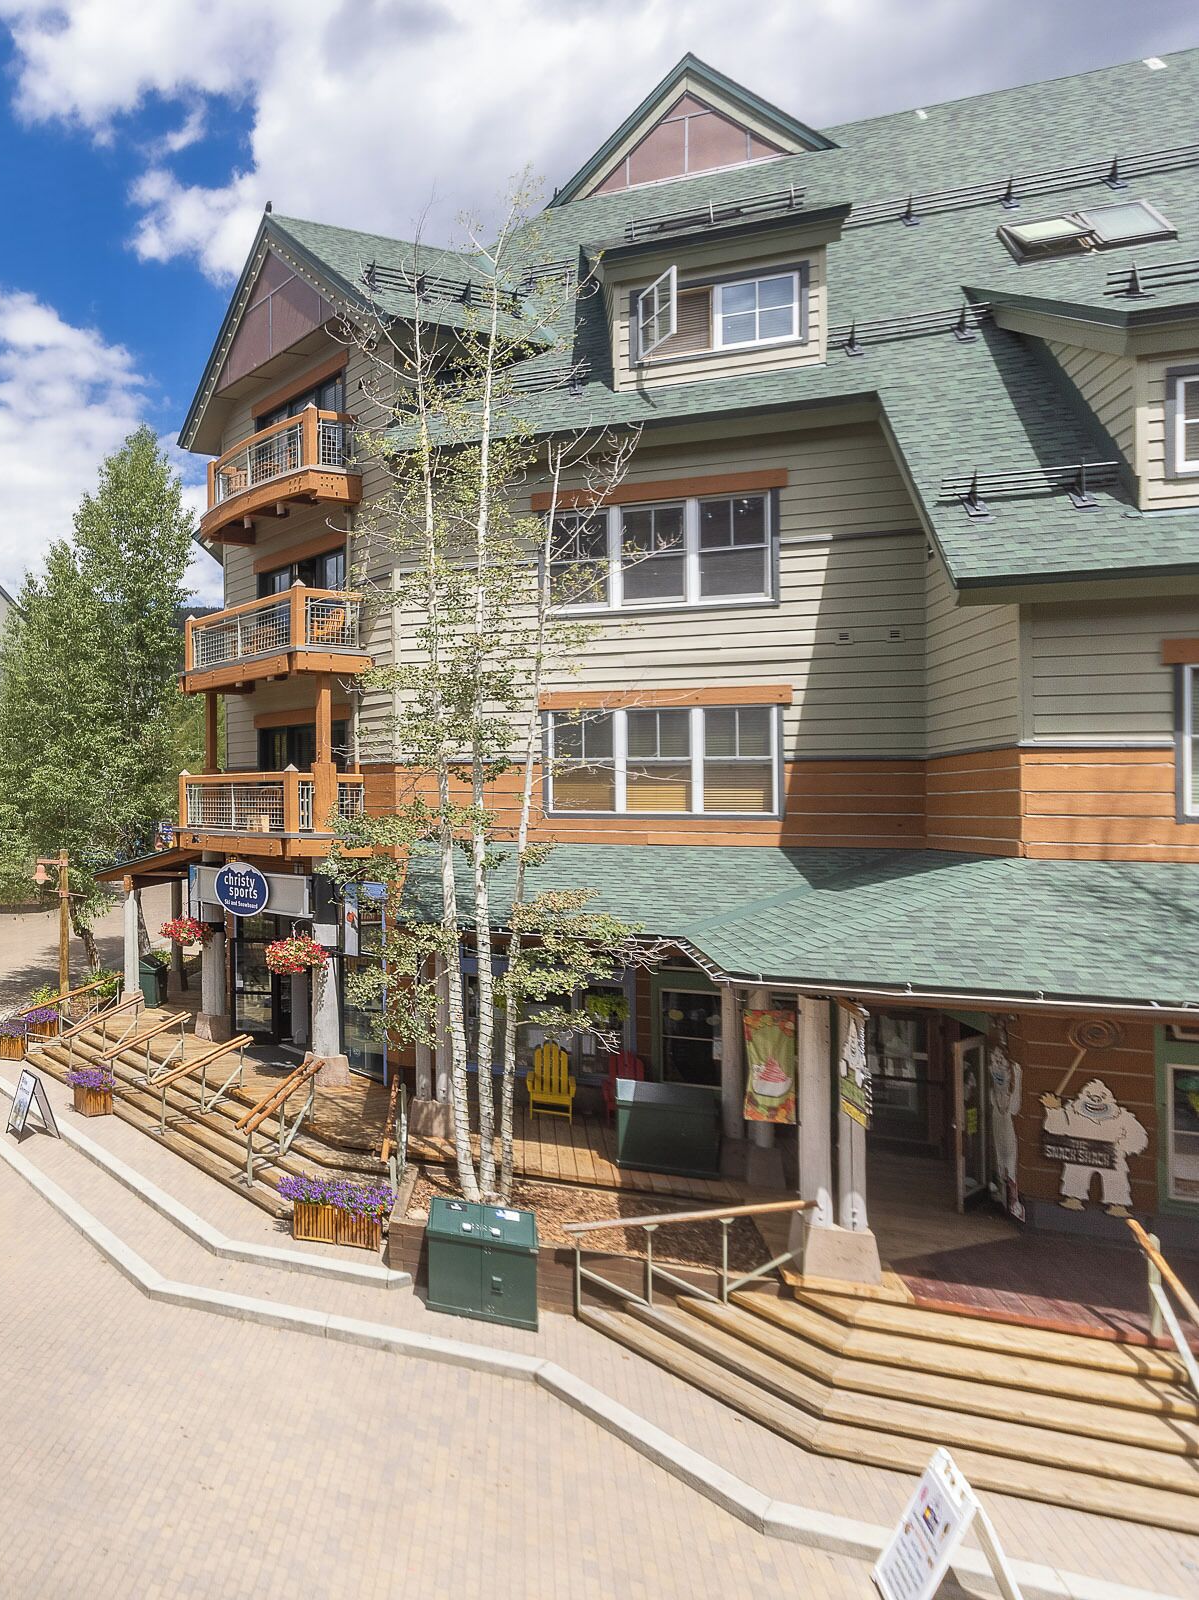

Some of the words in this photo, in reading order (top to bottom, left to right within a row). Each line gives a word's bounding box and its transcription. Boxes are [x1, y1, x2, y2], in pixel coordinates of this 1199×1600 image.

[224, 873, 255, 889] christy
[229, 887, 258, 900] sports
[238, 901, 258, 909] Snowboard
